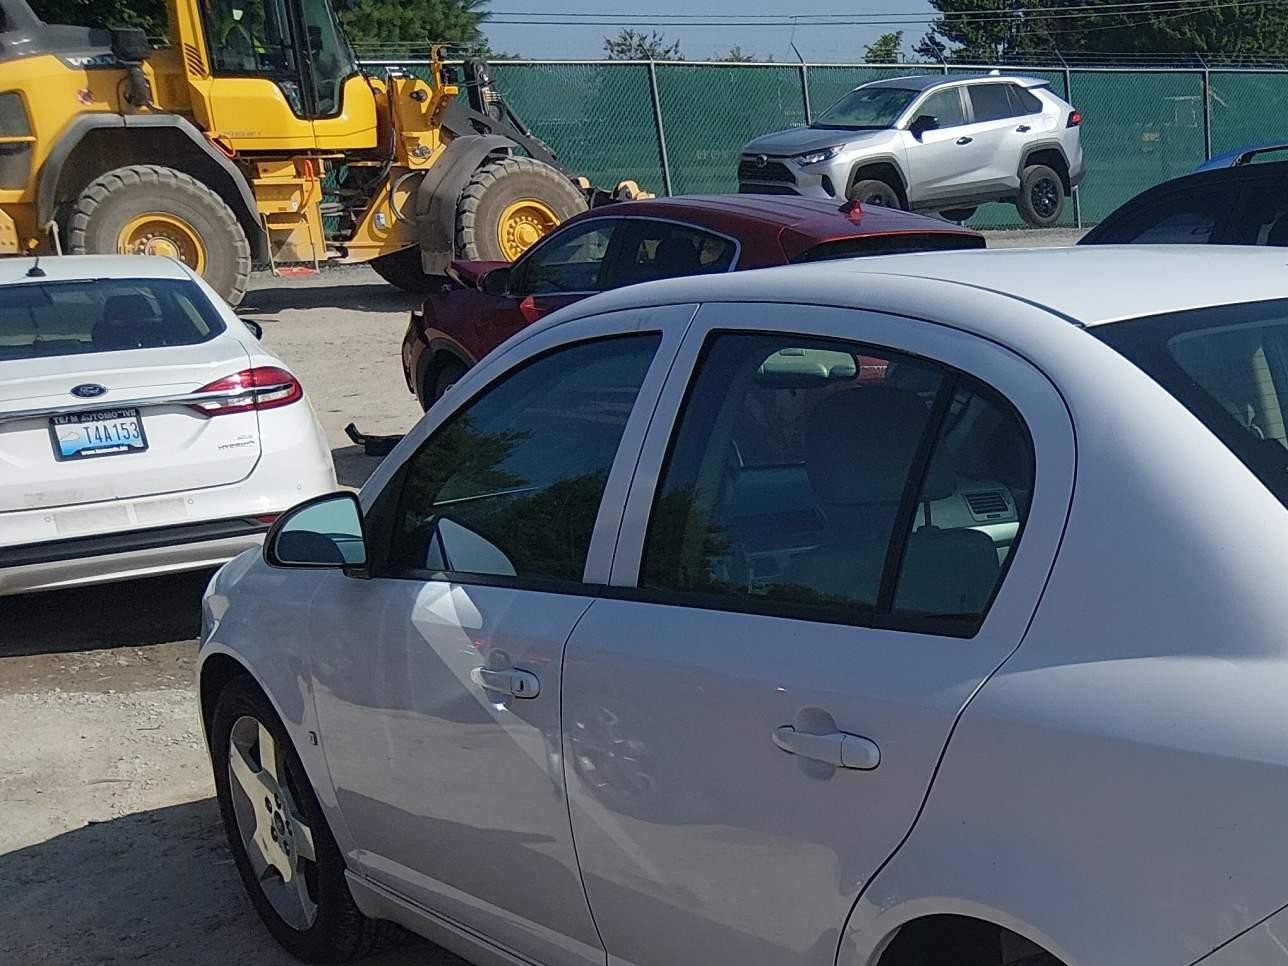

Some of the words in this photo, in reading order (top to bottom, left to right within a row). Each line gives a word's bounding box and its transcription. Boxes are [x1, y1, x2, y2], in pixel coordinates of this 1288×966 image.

[53, 414, 80, 425] TEAM
[80, 408, 137, 422] AUTOMOTIVE
[82, 421, 140, 444] T4A153
